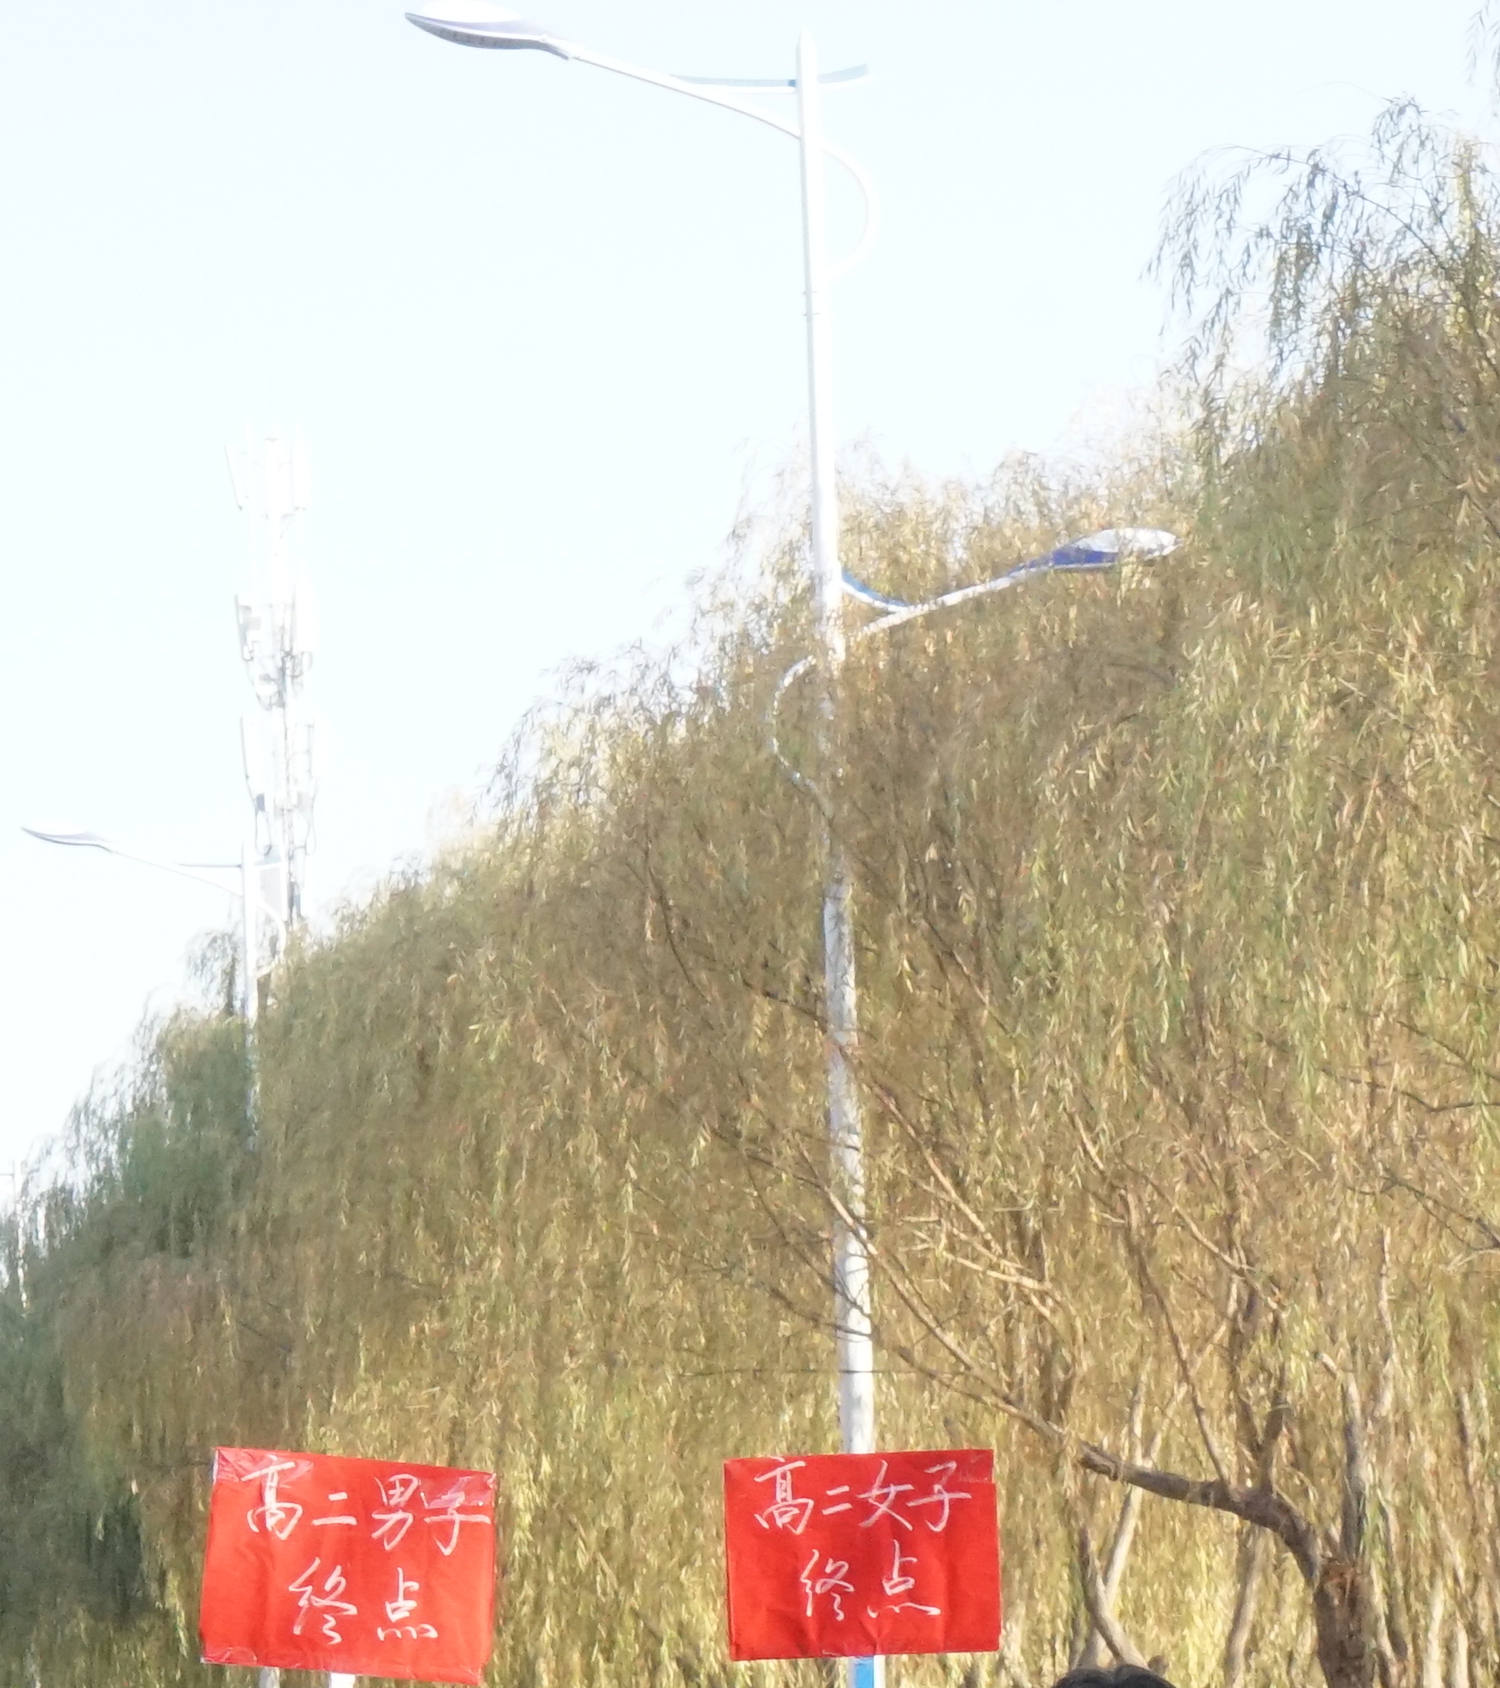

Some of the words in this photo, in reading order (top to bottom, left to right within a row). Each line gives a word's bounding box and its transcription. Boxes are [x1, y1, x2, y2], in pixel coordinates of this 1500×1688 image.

[241, 1454, 491, 1556] 高二男子
[753, 1455, 972, 1535] 高二女子
[288, 1556, 439, 1644] 终点
[800, 1539, 942, 1621] 终点
